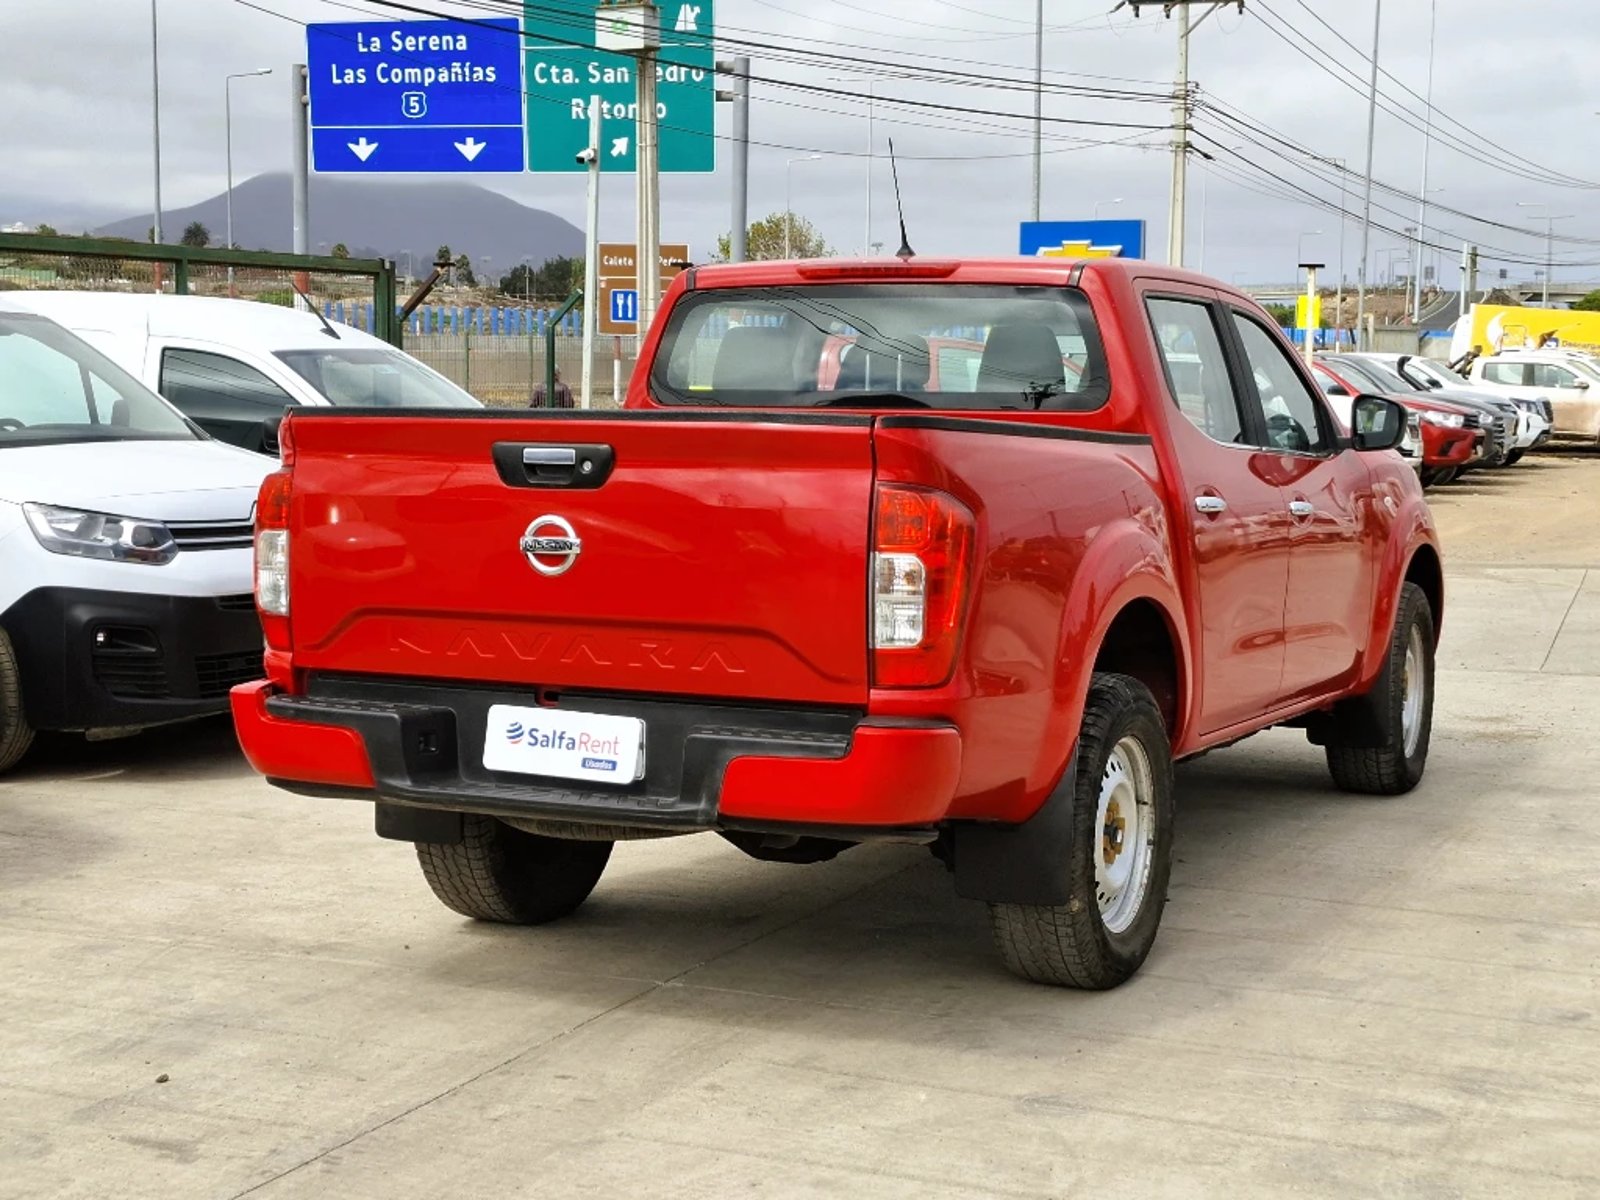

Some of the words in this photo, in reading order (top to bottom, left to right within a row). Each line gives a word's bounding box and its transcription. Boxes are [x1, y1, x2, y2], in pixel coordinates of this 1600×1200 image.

[357, 32, 381, 52] La
[391, 30, 467, 51] Serena
[331, 63, 367, 84] Las
[376, 62, 496, 87] Compañías
[534, 62, 580, 84] Cta.
[588, 62, 629, 83] San
[655, 64, 705, 83] edro
[409, 96, 420, 114] 5
[571, 98, 667, 120] Rtoro
[523, 539, 574, 552] NISSAN
[389, 627, 746, 674] NAVARA
[527, 727, 621, 756] SalfaRent
